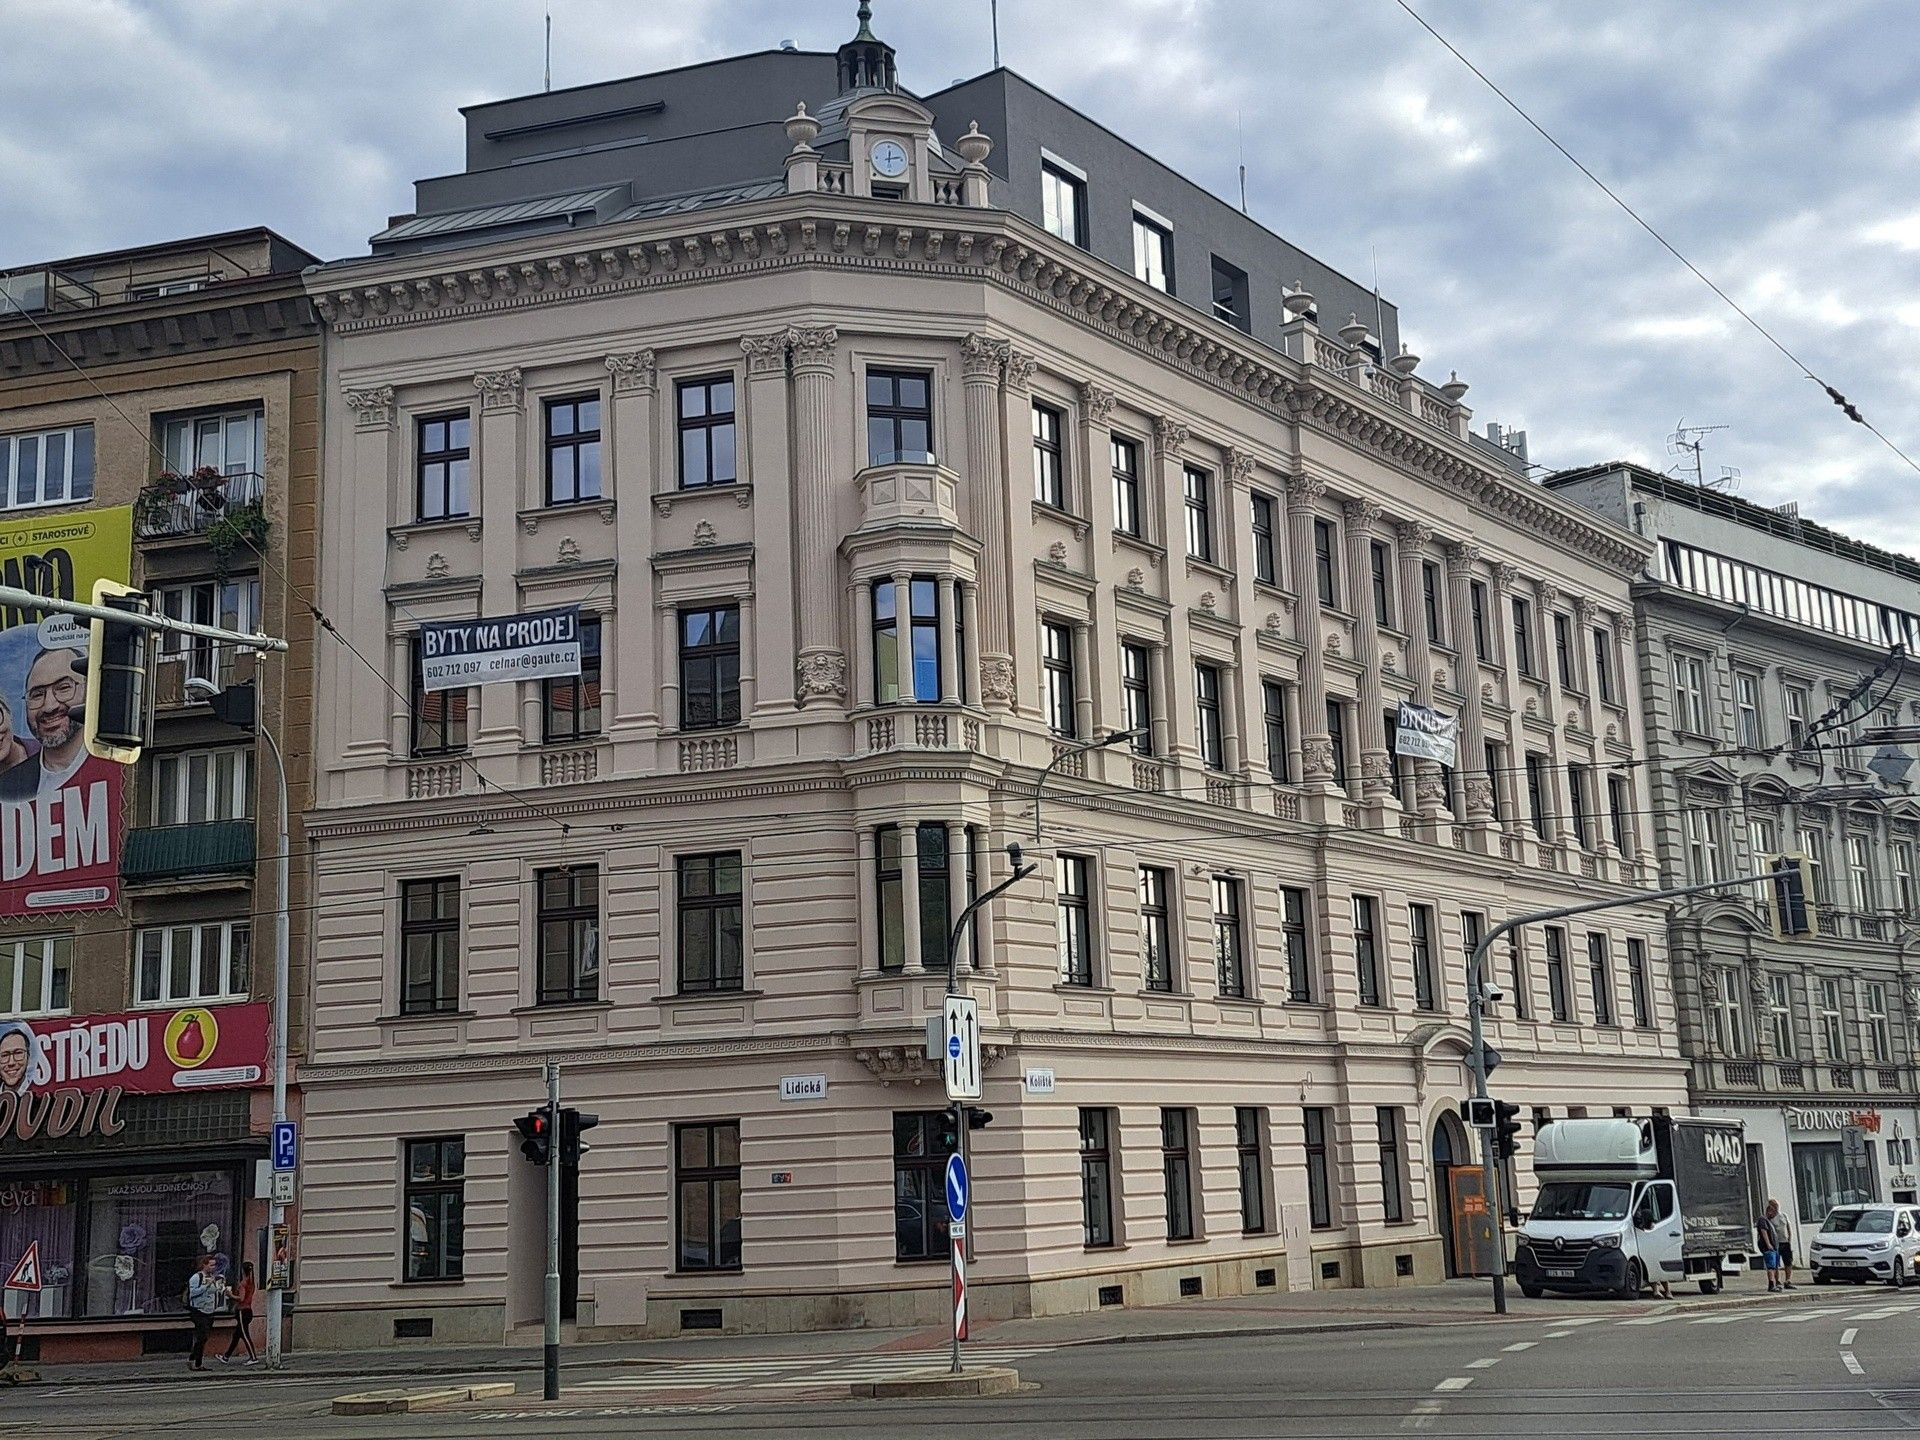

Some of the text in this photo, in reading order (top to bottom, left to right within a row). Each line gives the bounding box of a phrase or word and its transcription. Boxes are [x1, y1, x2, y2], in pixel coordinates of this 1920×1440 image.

[32, 525, 90, 542] STAROSTOVÉ
[425, 615, 574, 656] BYTY NA PRODEJ
[427, 651, 576, 678] 602 712 097 celnar@gaute.cz
[1, 780, 110, 882] DEM
[33, 1017, 149, 1086] STŘEDU
[786, 1080, 821, 1094] Lidická
[1797, 1110, 1850, 1131] LOUNGE
[280, 1128, 292, 1155] P
[0, 1188, 36, 1215] eya
